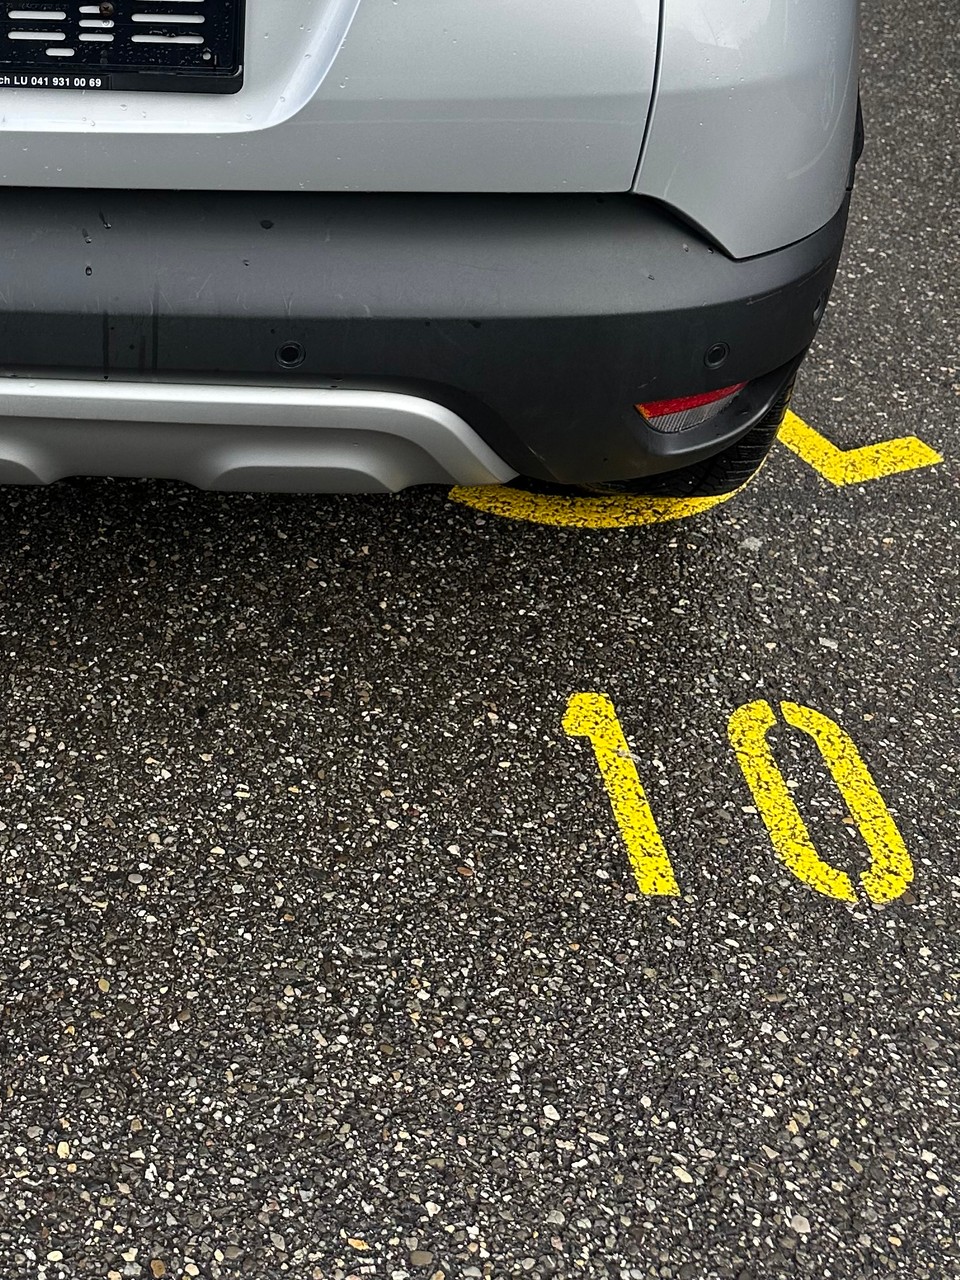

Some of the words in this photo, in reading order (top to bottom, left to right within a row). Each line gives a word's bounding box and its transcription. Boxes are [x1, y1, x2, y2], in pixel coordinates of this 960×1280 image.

[14, 75, 28, 85] LU
[30, 76, 49, 86] 041
[52, 77, 70, 87] 931
[73, 78, 86, 87] 00
[89, 78, 102, 87] 69
[562, 692, 914, 904] 10
